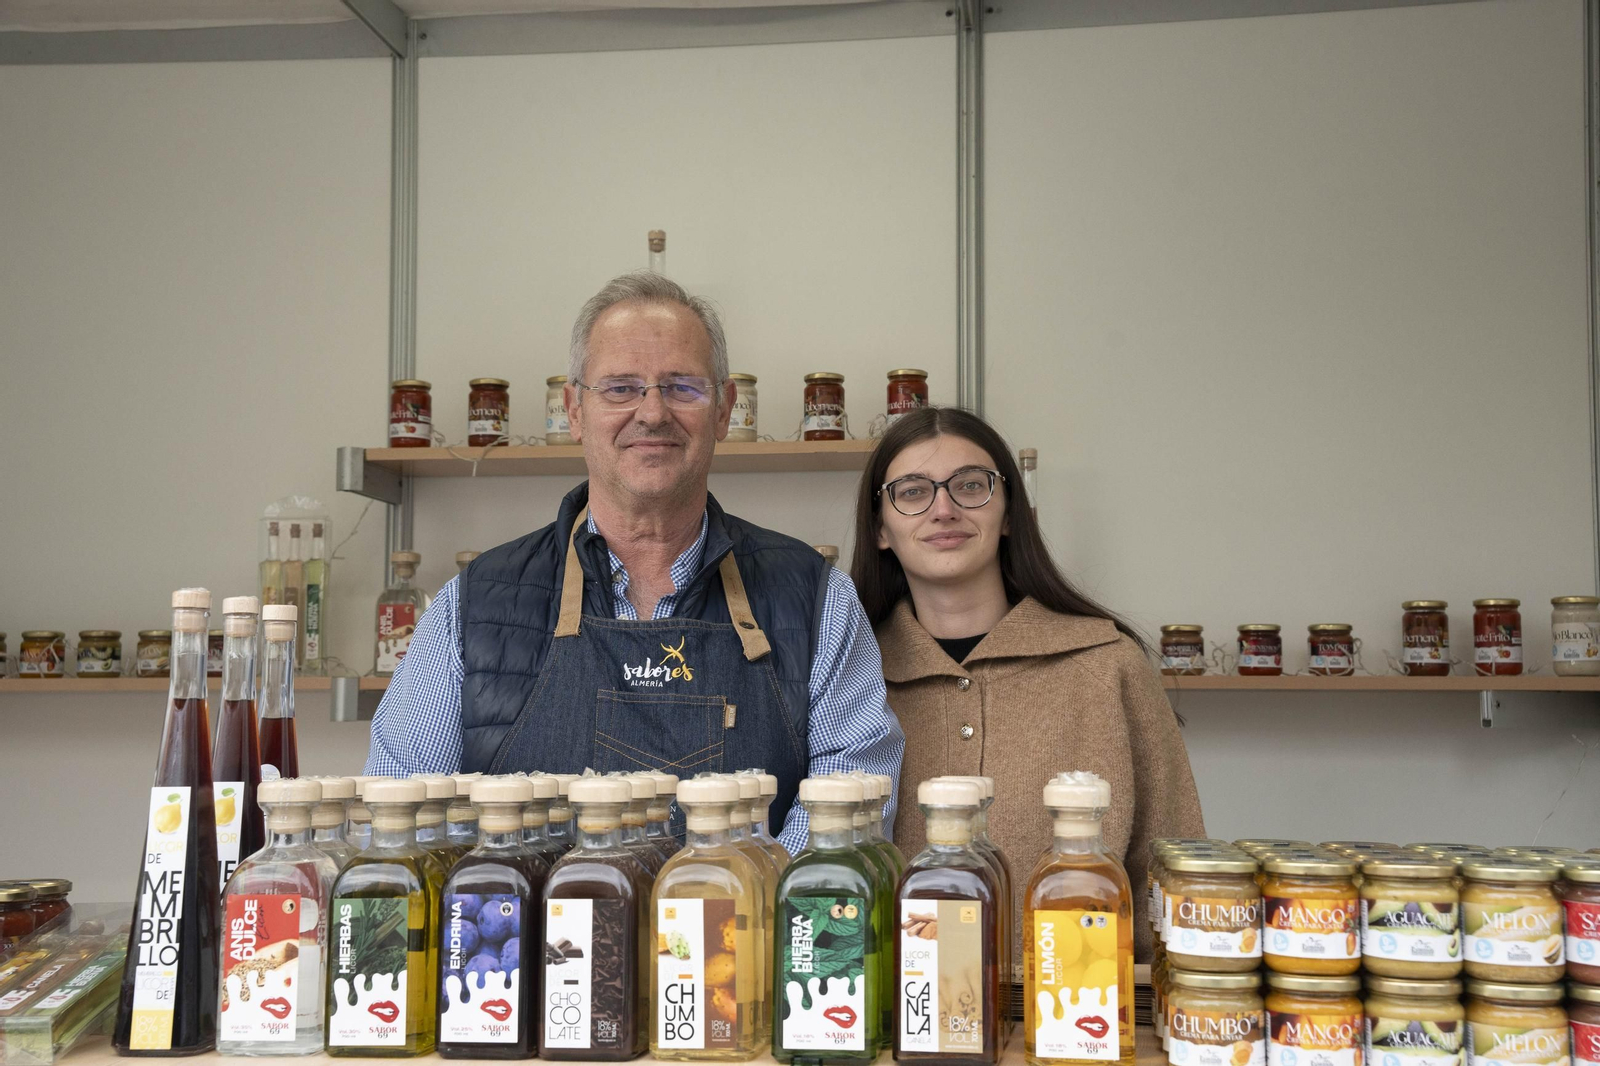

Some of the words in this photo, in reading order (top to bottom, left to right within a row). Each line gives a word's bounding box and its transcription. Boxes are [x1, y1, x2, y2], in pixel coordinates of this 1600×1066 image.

[623, 657, 694, 682] sabores
[630, 679, 664, 688] ALMERÍA
[147, 853, 162, 864] DE
[143, 870, 182, 894] ME
[150, 890, 178, 918] M
[1179, 902, 1257, 923] CHUMBO
[1279, 906, 1345, 924] MANGO
[140, 918, 182, 944] BRI
[242, 899, 258, 961] DULCE
[338, 904, 352, 974] HIERBAS
[450, 902, 462, 970] ENDRINA
[230, 918, 244, 962] ANIS
[792, 914, 803, 973] HIERBA
[802, 918, 814, 973] BUENA
[137, 945, 179, 966] LLO
[904, 950, 930, 960] LICOR
[1038, 922, 1056, 986] LIMÓN
[904, 960, 916, 968] DE
[156, 990, 169, 1000] DE
[550, 992, 582, 1006] CHO
[664, 983, 695, 1004] CH
[904, 981, 930, 999] CA
[550, 1006, 582, 1025] CO
[664, 1005, 695, 1022] UM
[906, 998, 930, 1017] NE
[260, 1022, 290, 1030] SABOR
[548, 1026, 581, 1040] LATE
[598, 1020, 612, 1031] 18%
[664, 1022, 695, 1040] BO
[712, 1020, 725, 1031] 18%
[906, 1014, 930, 1036] LA
[949, 1016, 970, 1032] 18%
[1174, 1014, 1251, 1036] CHUMBO
[1286, 1021, 1353, 1041] MANGO
[824, 1032, 856, 1040] SABOR
[950, 1032, 970, 1043] VOL
[1077, 1042, 1108, 1050] SABOR
